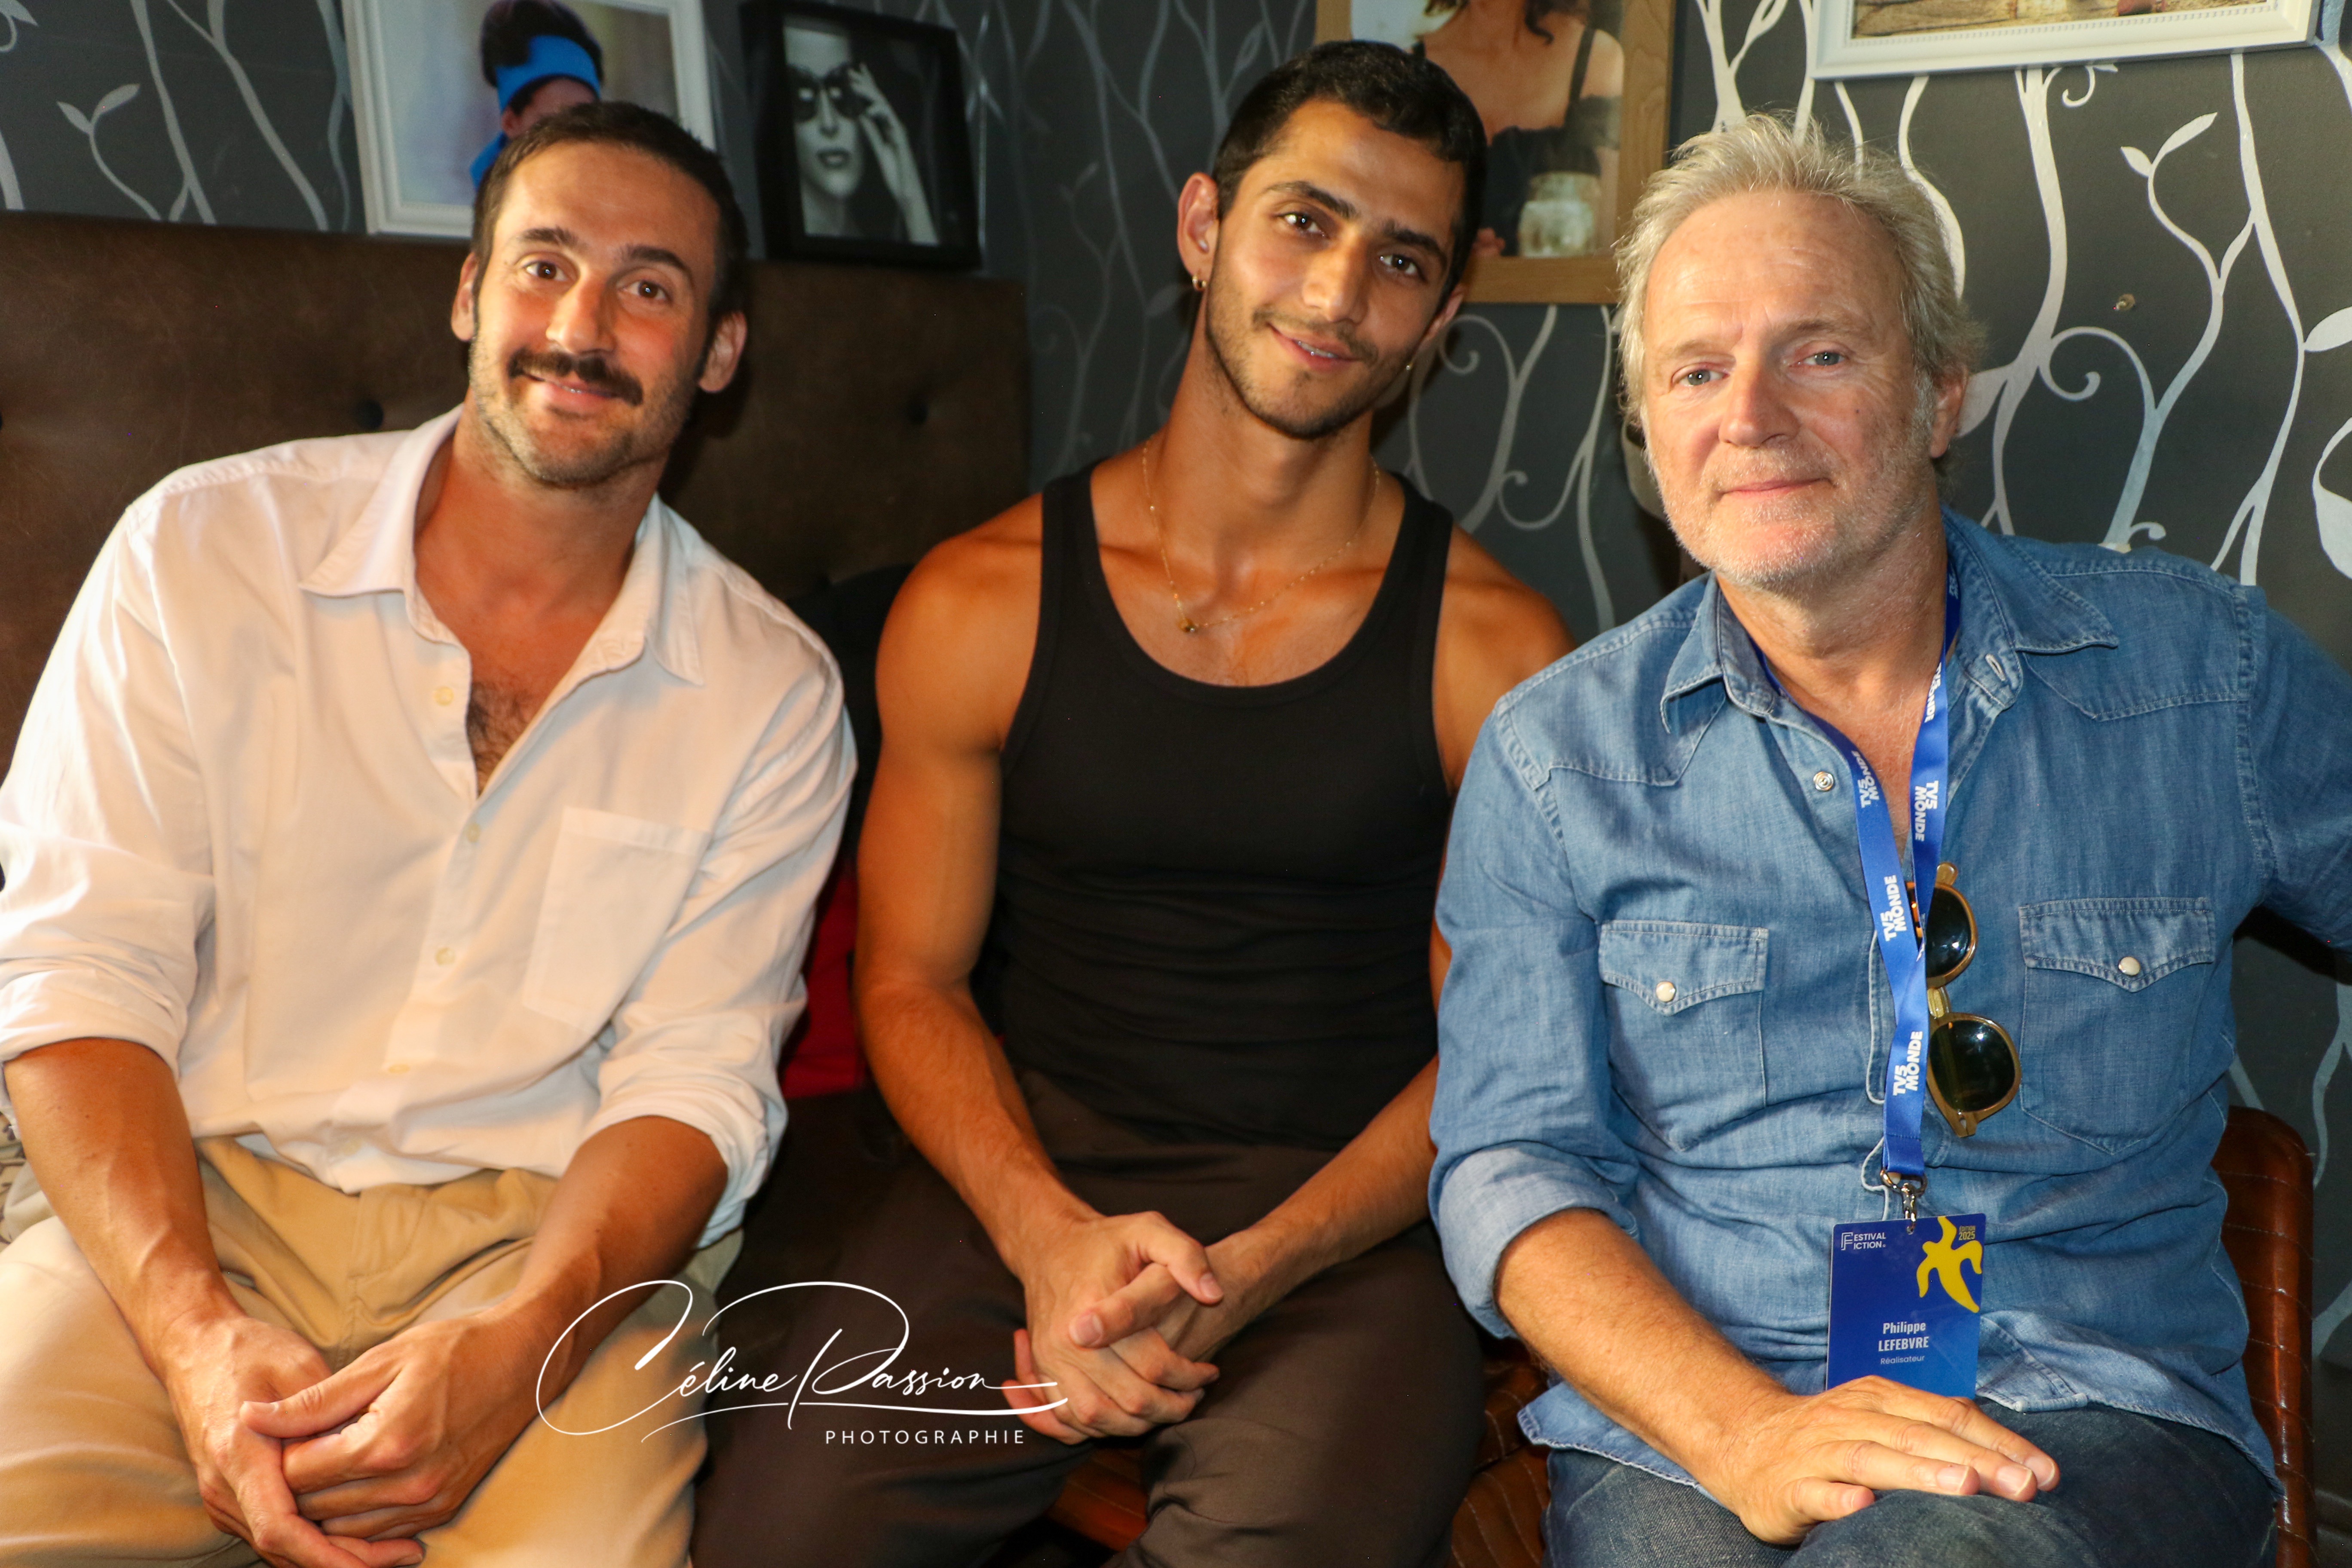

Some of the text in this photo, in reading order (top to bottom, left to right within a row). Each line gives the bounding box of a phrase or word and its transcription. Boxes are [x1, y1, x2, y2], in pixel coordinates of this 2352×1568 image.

[1924, 683, 1936, 723] ONDE
[1857, 778, 1871, 808] TV5
[1926, 780, 1939, 809] TV5
[1914, 786, 1927, 842] MONDE
[1884, 875, 1907, 931] MONDE
[1880, 910, 1897, 941] TV5
[1905, 1031, 1923, 1091] MONDE
[1893, 1065, 1908, 1096] TV5
[1959, 1231, 1975, 1240] 2025
[1883, 1321, 1926, 1335] Philippe
[1878, 1336, 1929, 1352] LEFEBVRE
[1880, 1356, 1925, 1364] Réalisateur
